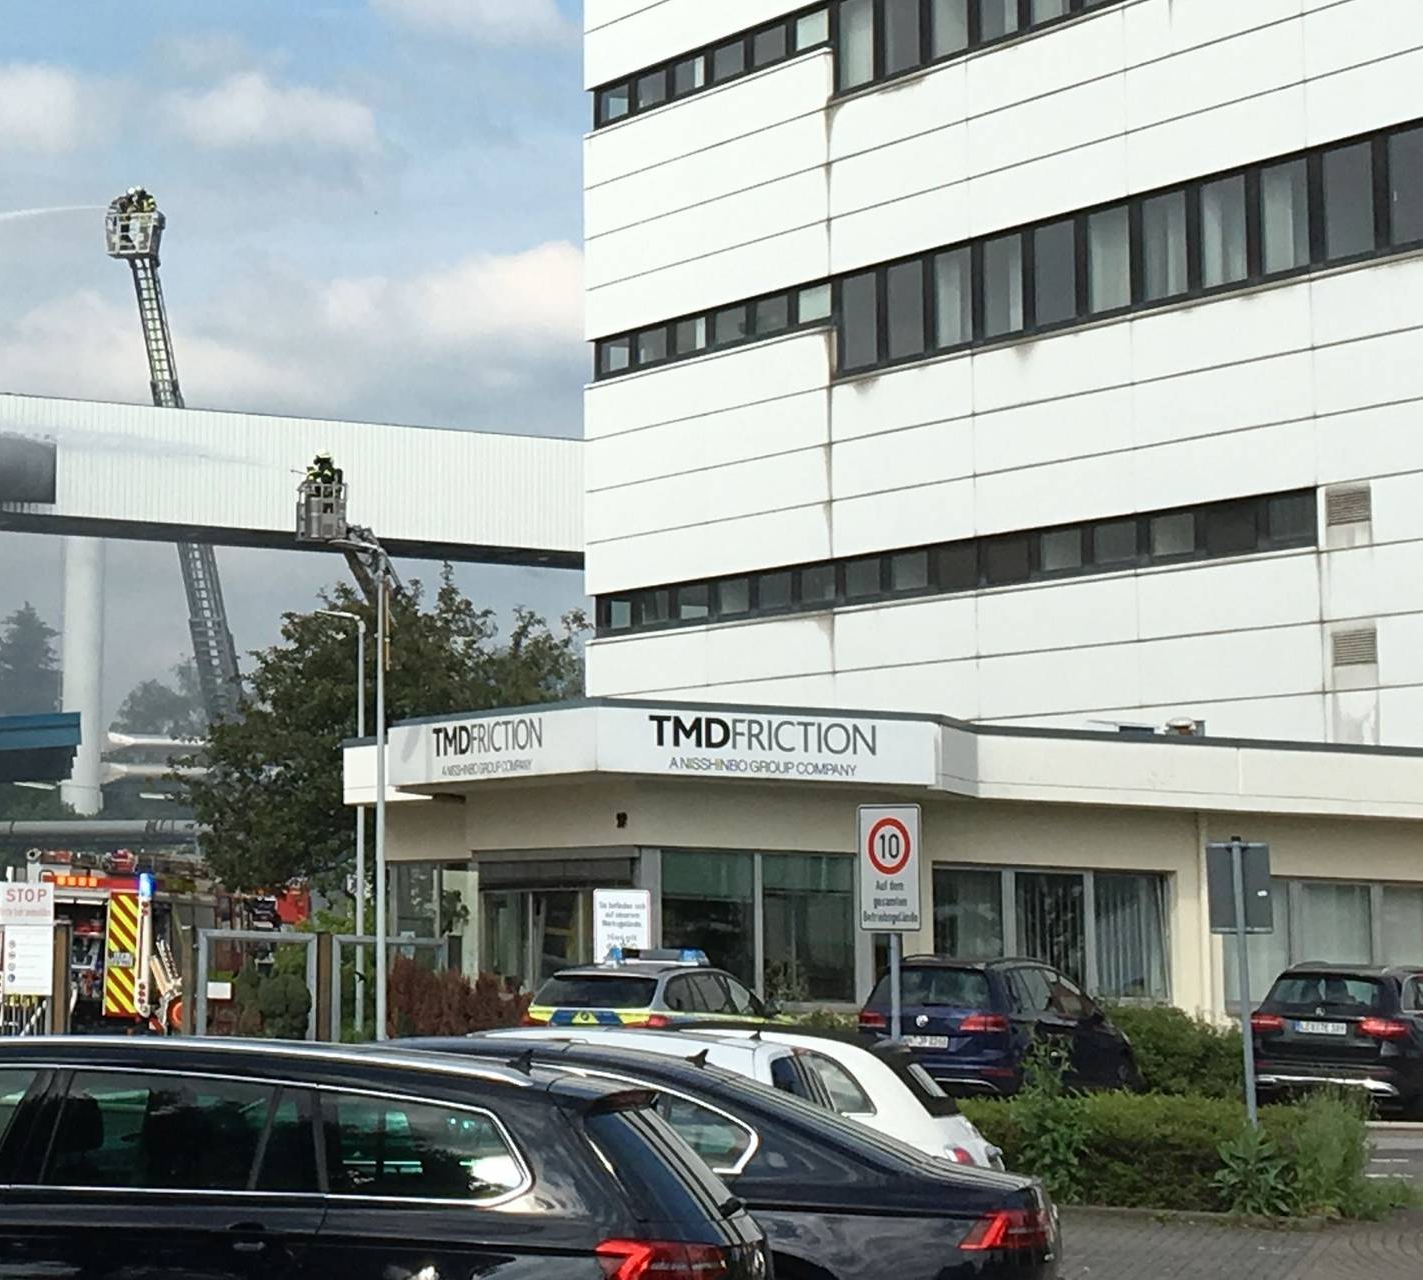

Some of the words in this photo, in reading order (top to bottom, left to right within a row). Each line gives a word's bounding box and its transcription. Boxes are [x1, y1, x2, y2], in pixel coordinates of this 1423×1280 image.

[669, 758, 678, 769] A
[680, 758, 747, 772] NISSHINBO
[750, 760, 794, 775] GROUP
[796, 762, 857, 776] COMPANY
[880, 833, 900, 859] 10
[876, 880, 888, 891] Auf
[890, 880, 904, 891] dem
[6, 888, 47, 902] STOP
